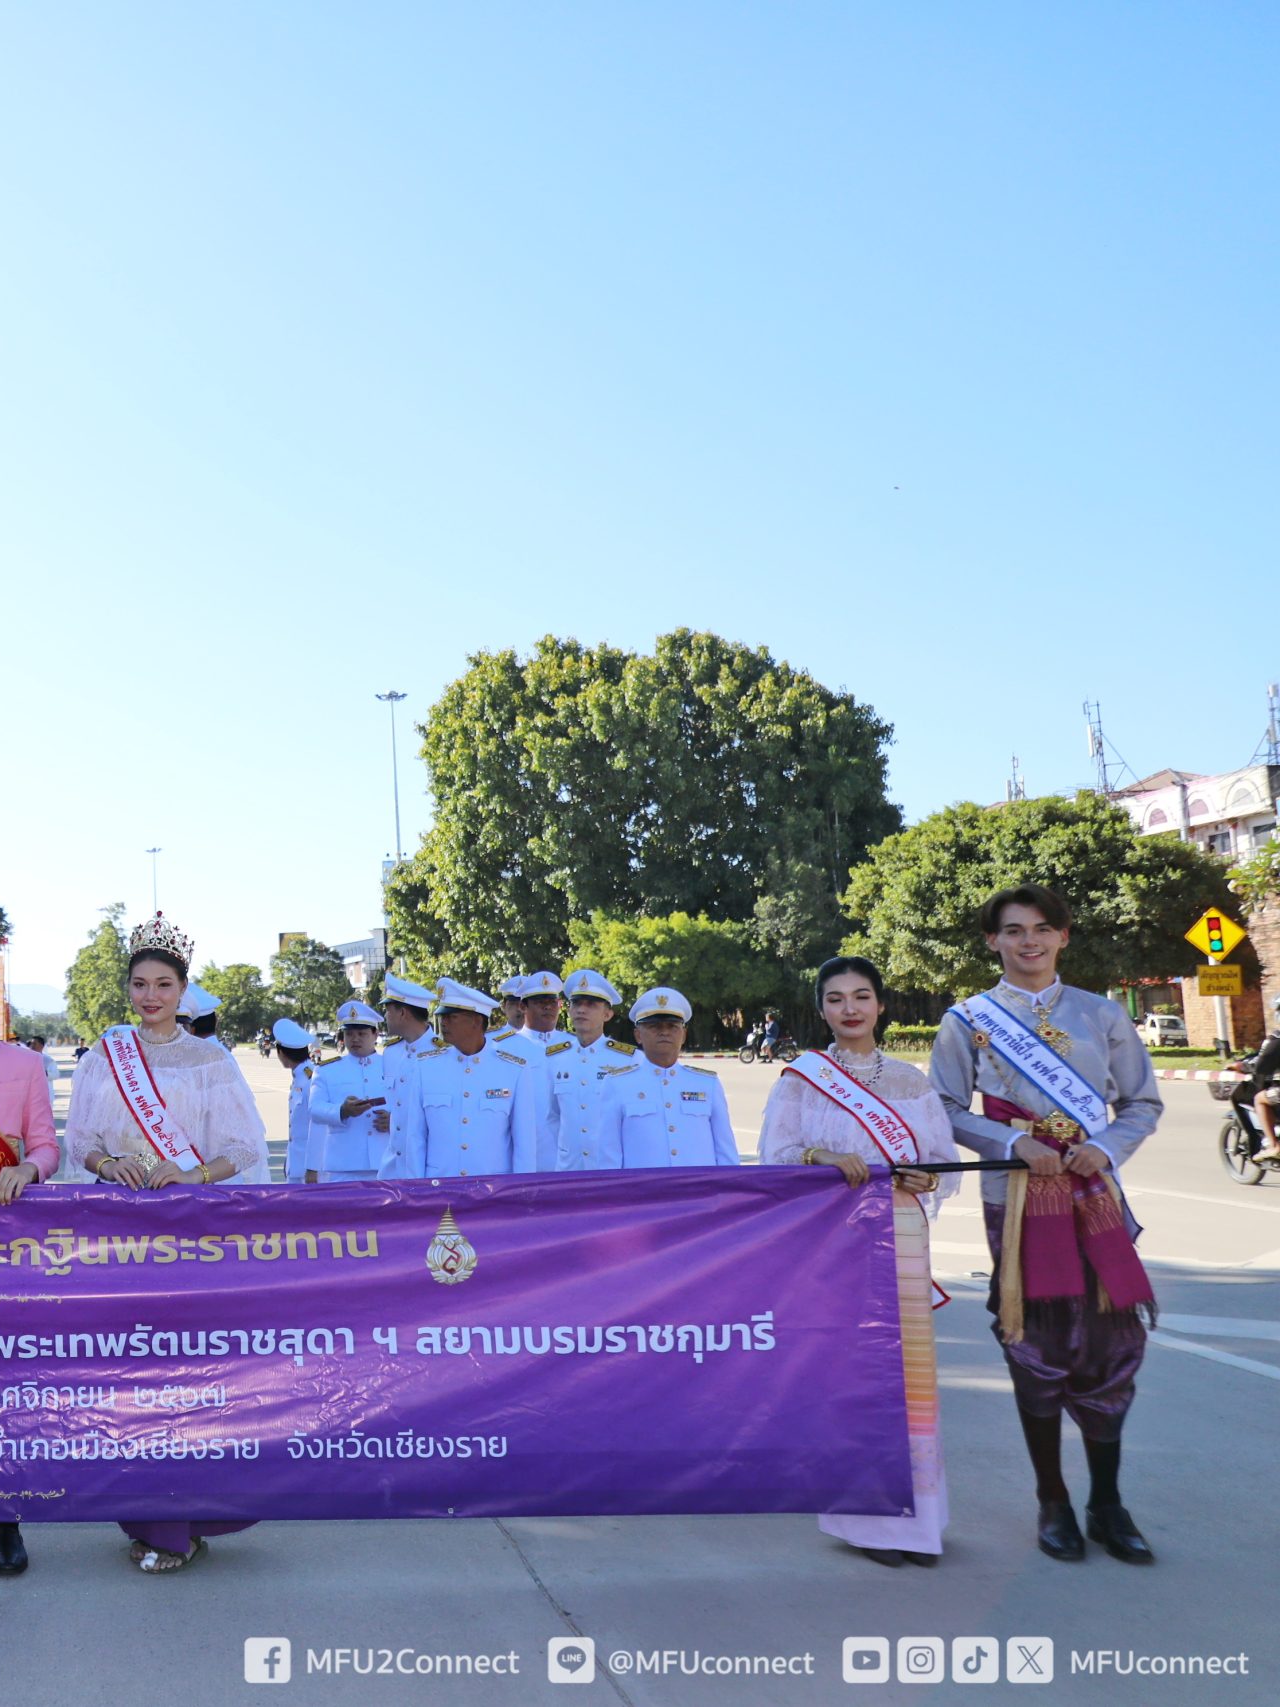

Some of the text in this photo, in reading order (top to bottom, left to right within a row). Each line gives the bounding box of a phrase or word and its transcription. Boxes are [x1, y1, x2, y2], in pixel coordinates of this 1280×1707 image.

[416, 1311, 776, 1364] สยามบรมราชกุมารี
[133, 1384, 226, 1408] ๒๕๖๗
[287, 1428, 507, 1461] จังหวัดเชียงราย
